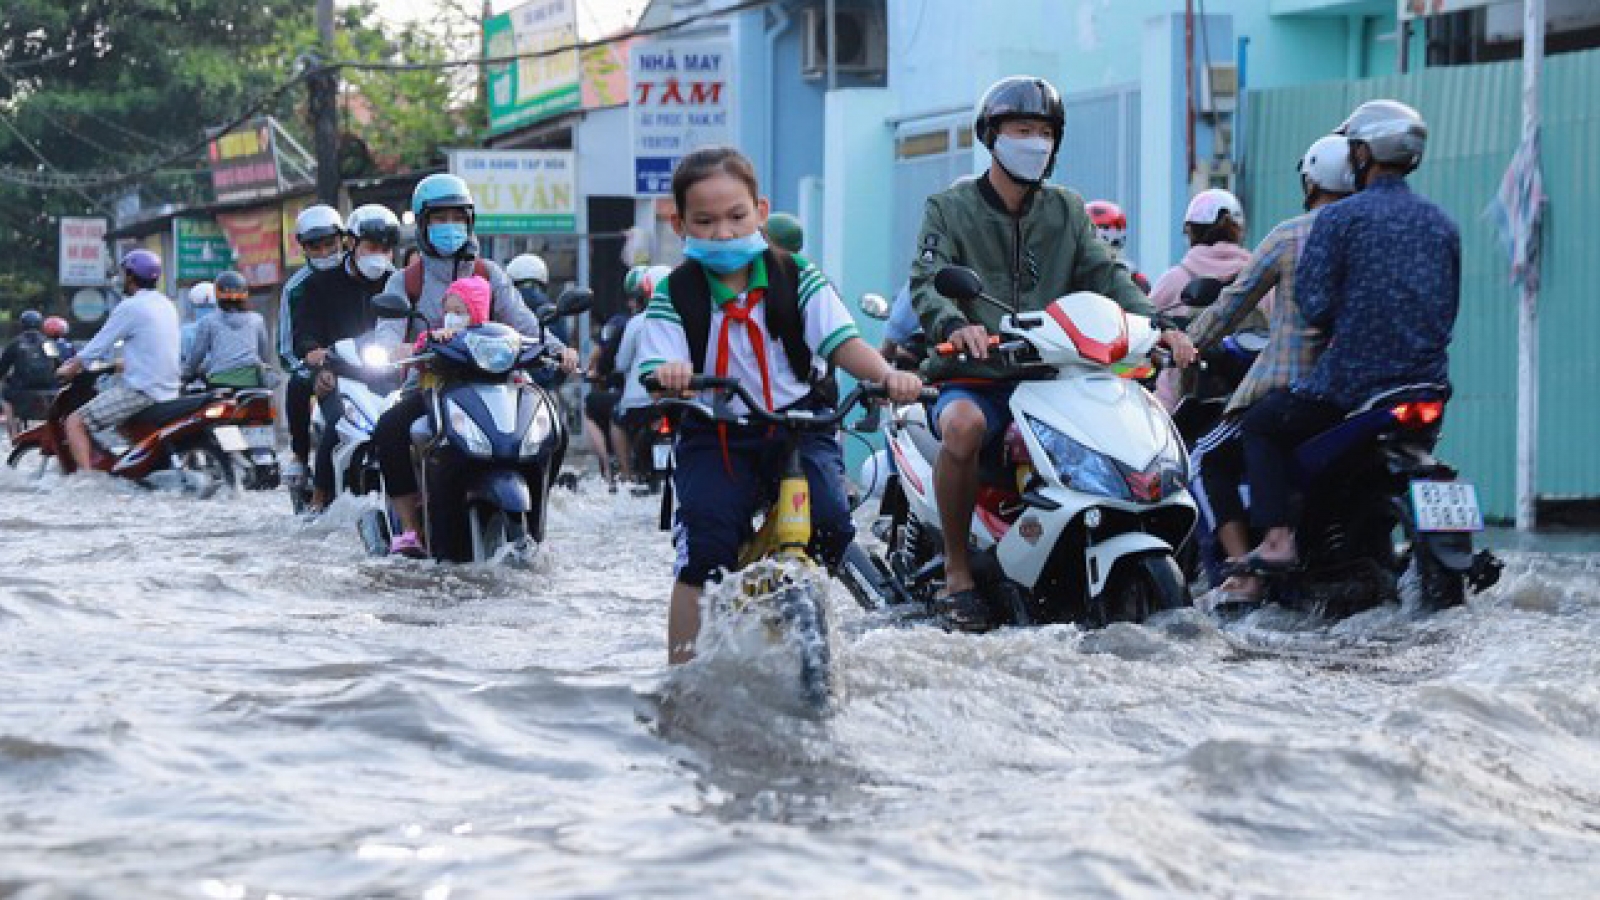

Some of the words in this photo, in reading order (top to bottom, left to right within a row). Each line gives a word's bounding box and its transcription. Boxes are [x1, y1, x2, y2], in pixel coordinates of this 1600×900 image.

[639, 50, 677, 71] NHÀ
[684, 54, 721, 71] MAY
[636, 78, 725, 105] TÂM
